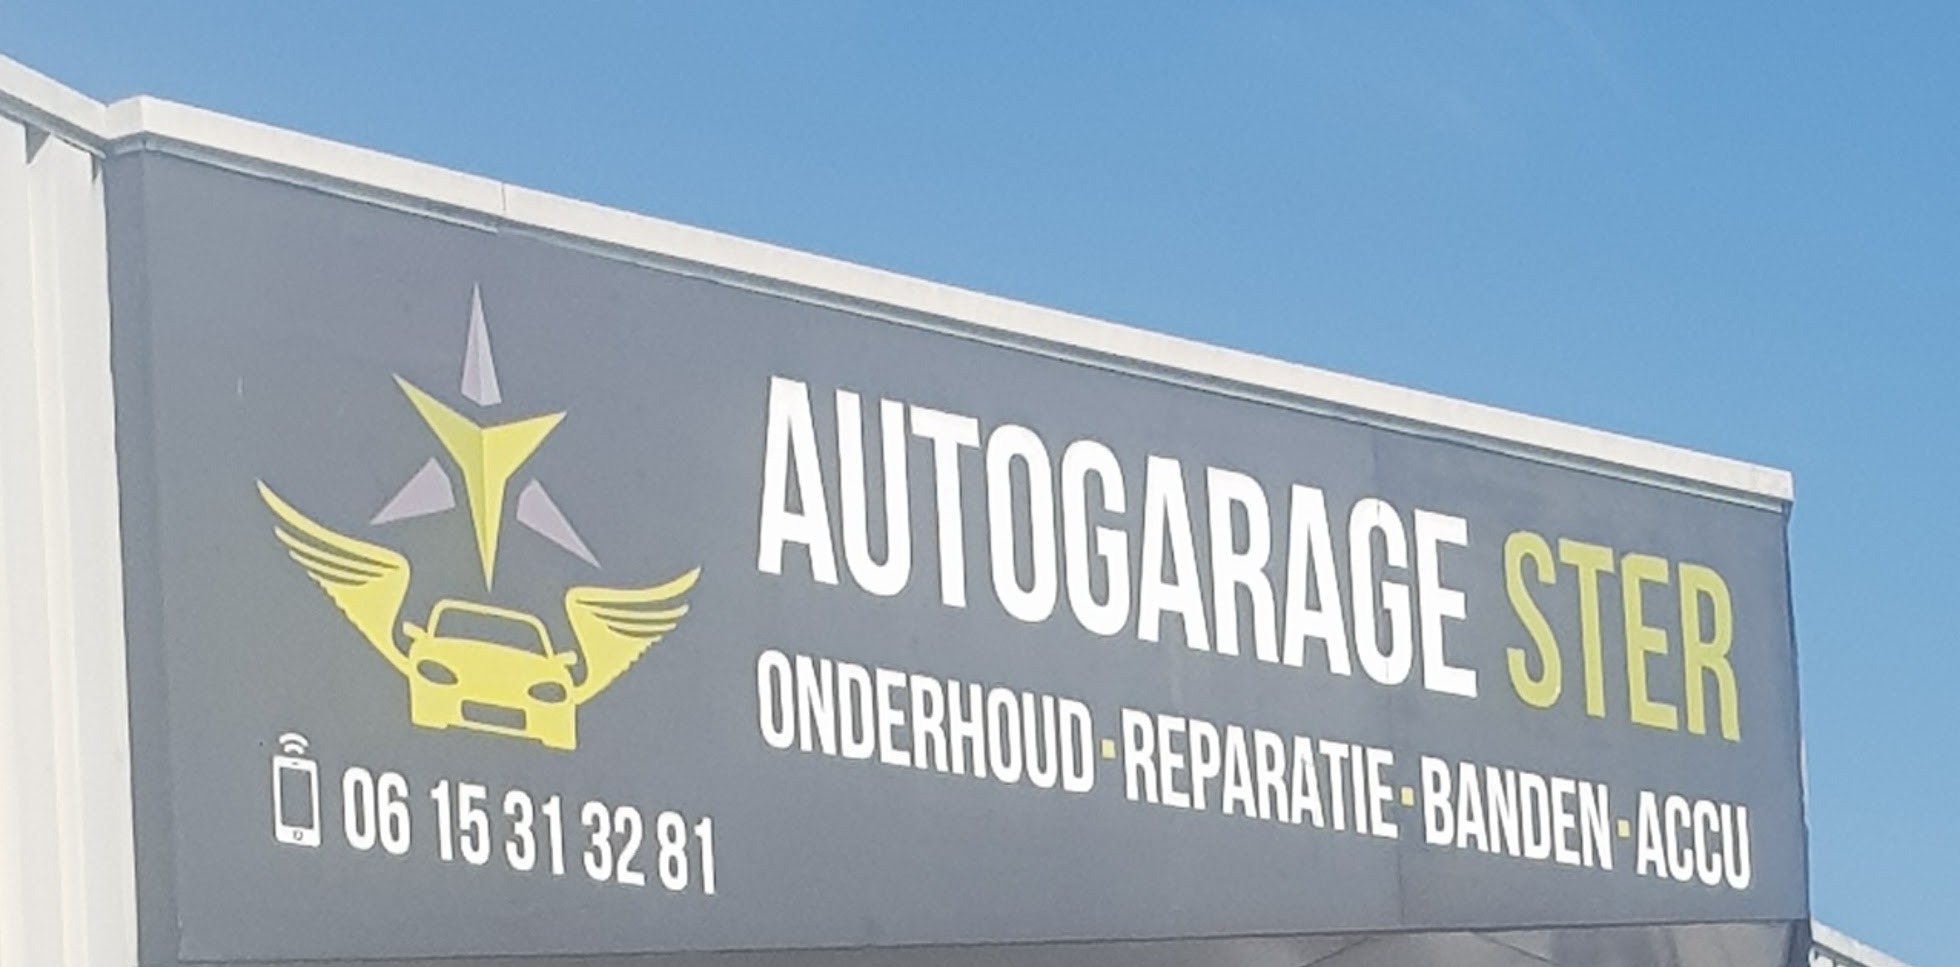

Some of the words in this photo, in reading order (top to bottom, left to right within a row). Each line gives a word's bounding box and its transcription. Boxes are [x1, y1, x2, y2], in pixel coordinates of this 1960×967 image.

[757, 375, 1479, 699] AUTOGARAGE
[1504, 530, 1741, 742] STER
[342, 766, 411, 855] 06
[430, 779, 491, 866] 15
[503, 789, 565, 876] 31
[581, 800, 646, 887] 32
[656, 811, 716, 895] 81
[757, 649, 1095, 793] ONDERHOUD
[1121, 707, 1399, 839] REPARATIE
[1421, 755, 1614, 871] BANDEN
[1636, 790, 1751, 890] ACCU
